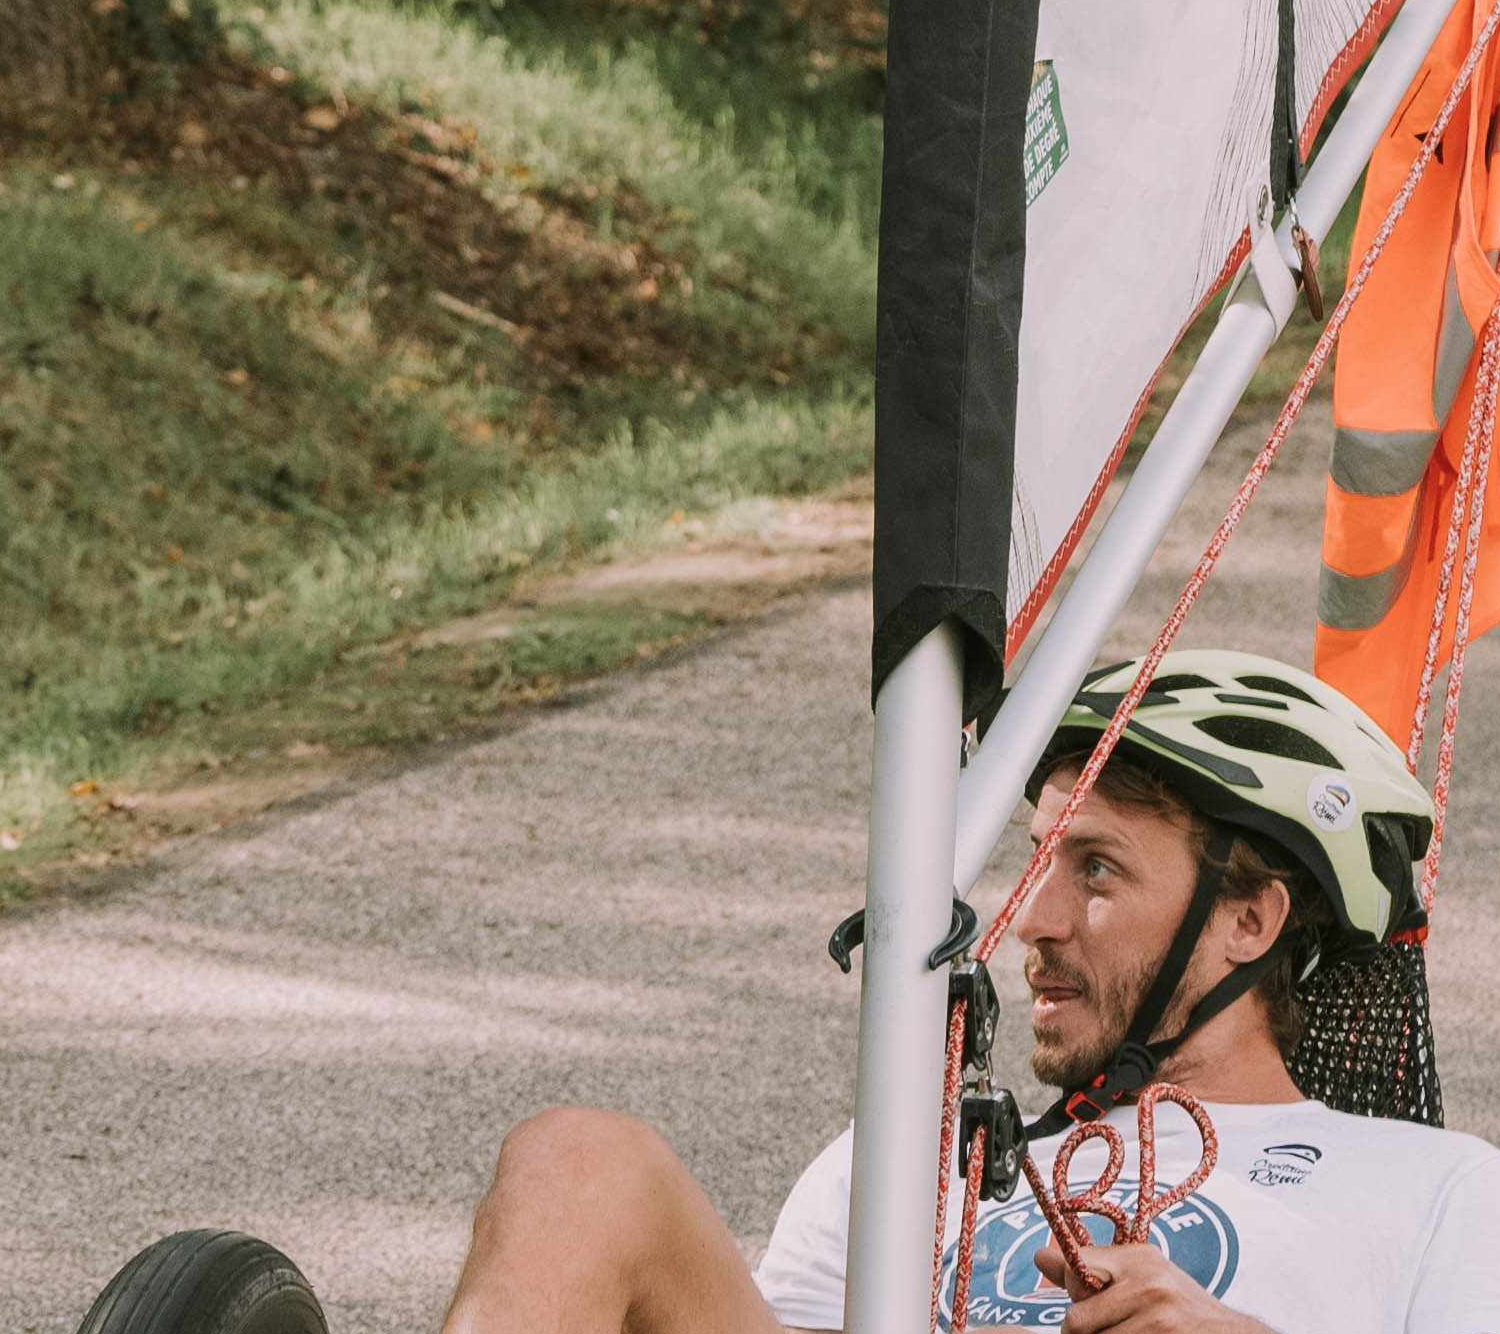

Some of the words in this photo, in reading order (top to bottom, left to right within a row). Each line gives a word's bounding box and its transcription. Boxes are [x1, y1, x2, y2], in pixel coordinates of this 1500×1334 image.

[1026, 74, 1053, 121] HAQUE
[1024, 152, 1035, 179] DE
[1034, 116, 1060, 165] DEGRÉ
[967, 1296, 1027, 1324] SANS
